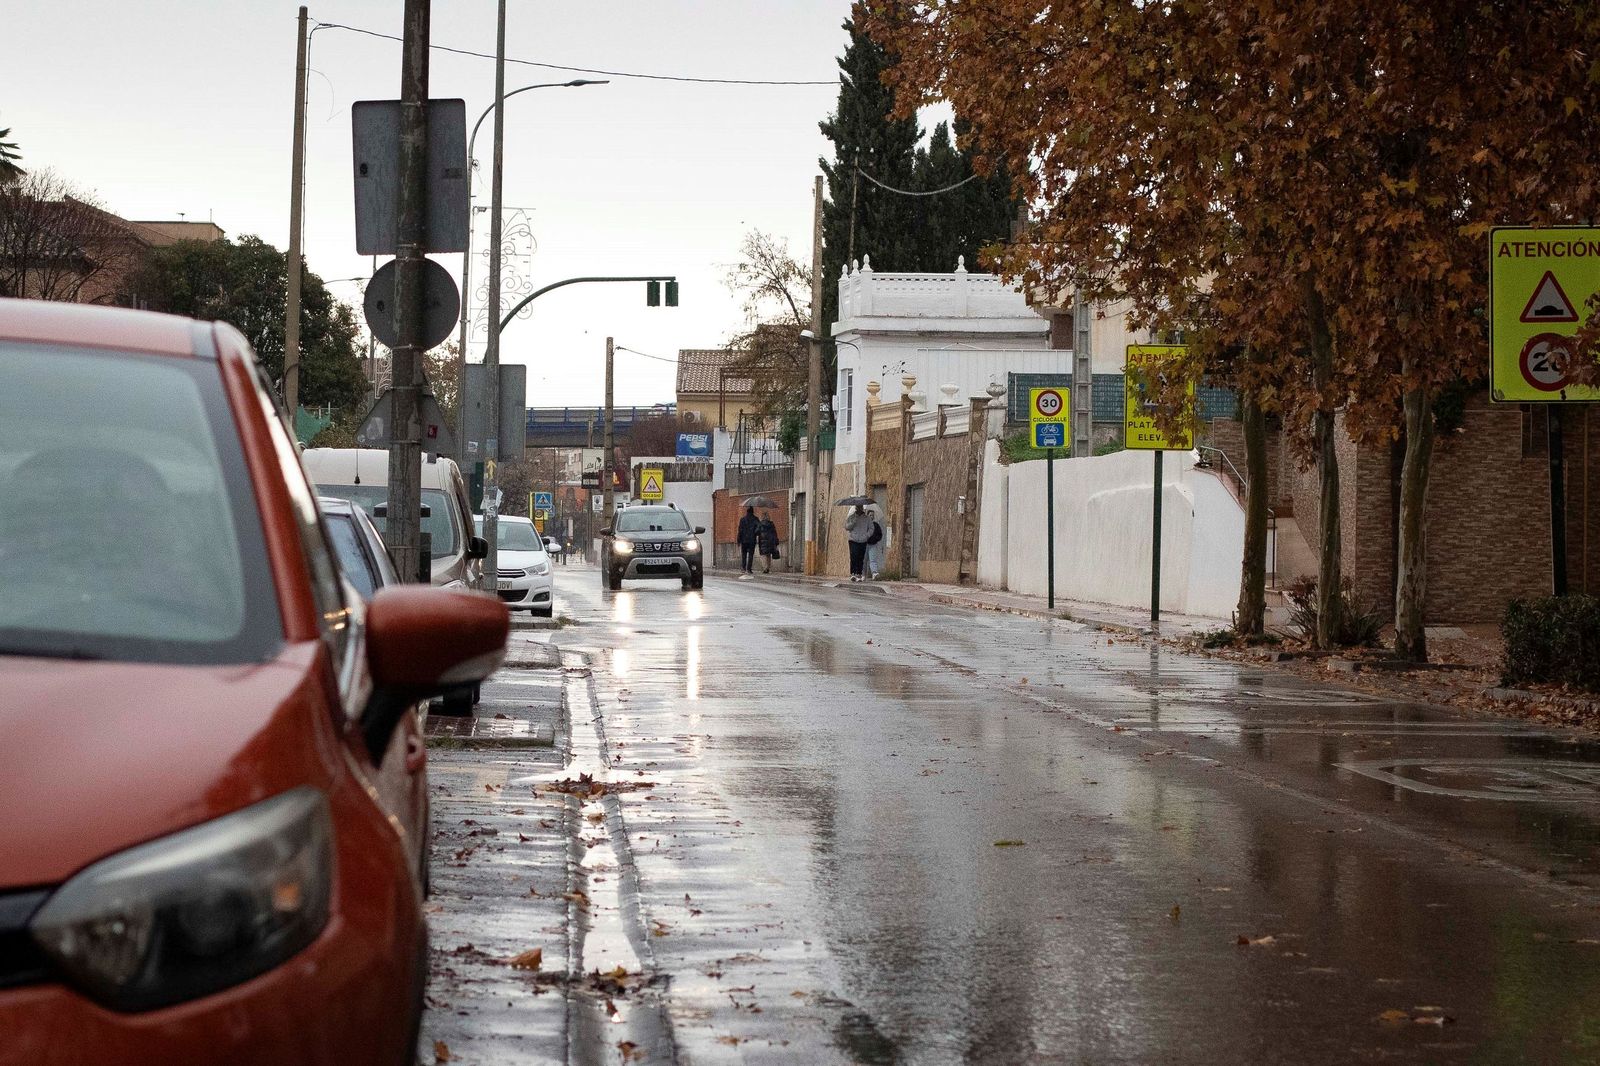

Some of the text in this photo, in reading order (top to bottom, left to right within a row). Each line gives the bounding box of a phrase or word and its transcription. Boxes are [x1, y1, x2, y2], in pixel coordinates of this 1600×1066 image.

[1498, 237, 1600, 258] ATENCIÓN
[1041, 398, 1058, 408] 30
[679, 433, 708, 442] PEPSI
